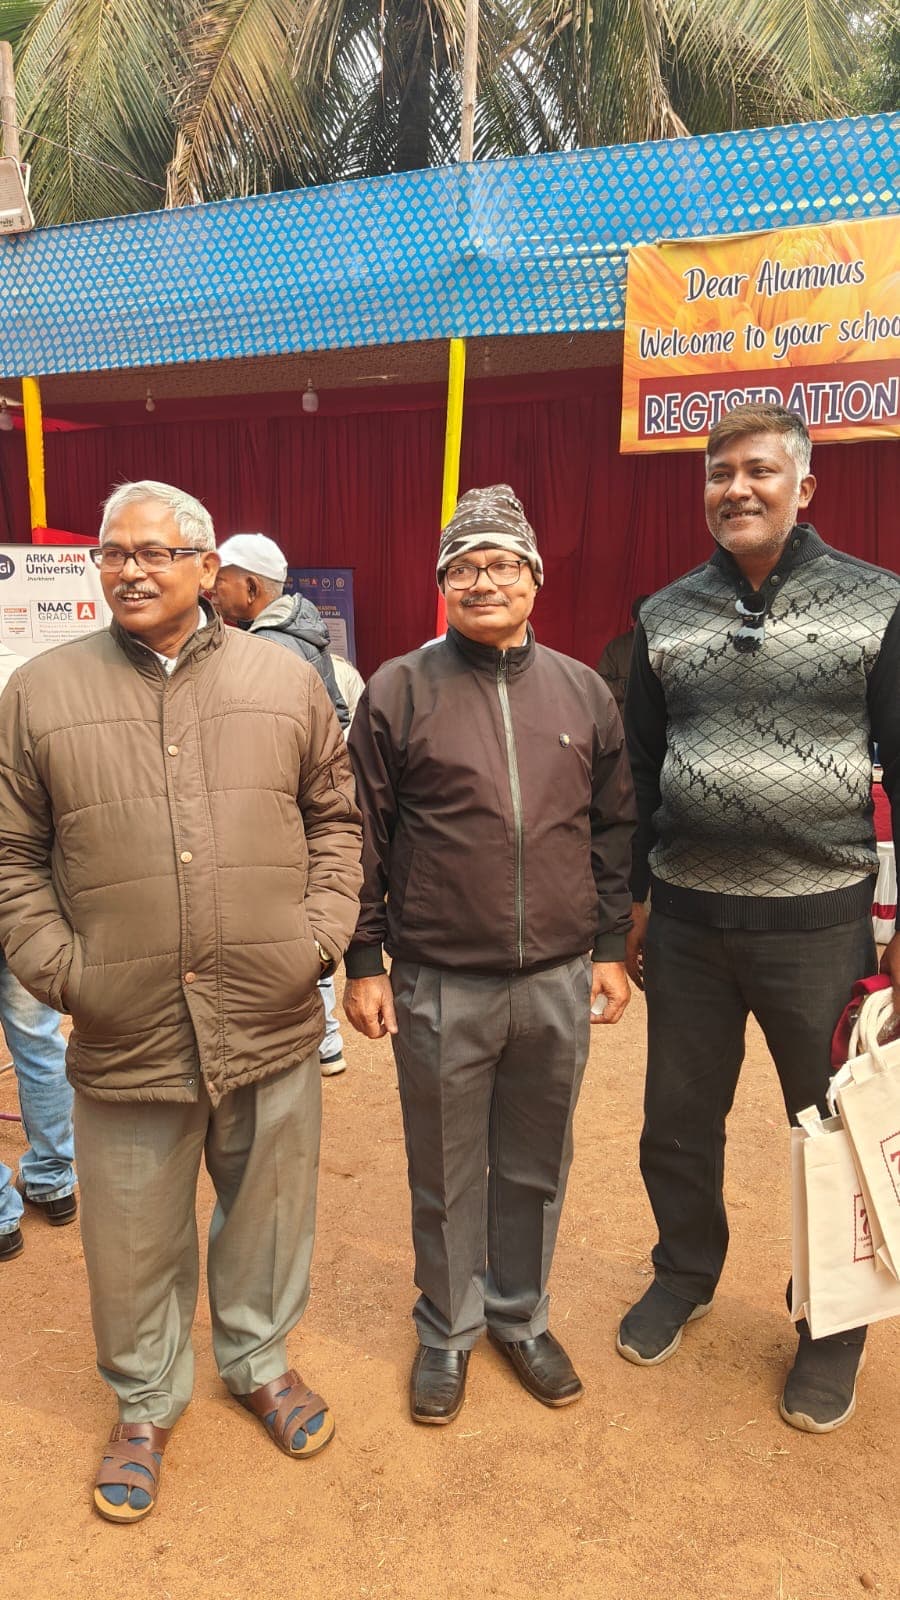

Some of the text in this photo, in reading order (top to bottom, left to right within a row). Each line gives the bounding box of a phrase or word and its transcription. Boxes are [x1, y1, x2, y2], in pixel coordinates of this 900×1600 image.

[684, 260, 865, 302] Dear Alumnus
[640, 310, 900, 358] Welcome to your schoo
[26, 553, 86, 563] ARKA JAIN
[26, 564, 86, 576] University
[37, 602, 72, 612] NAAC
[38, 612, 73, 621] GRADE
